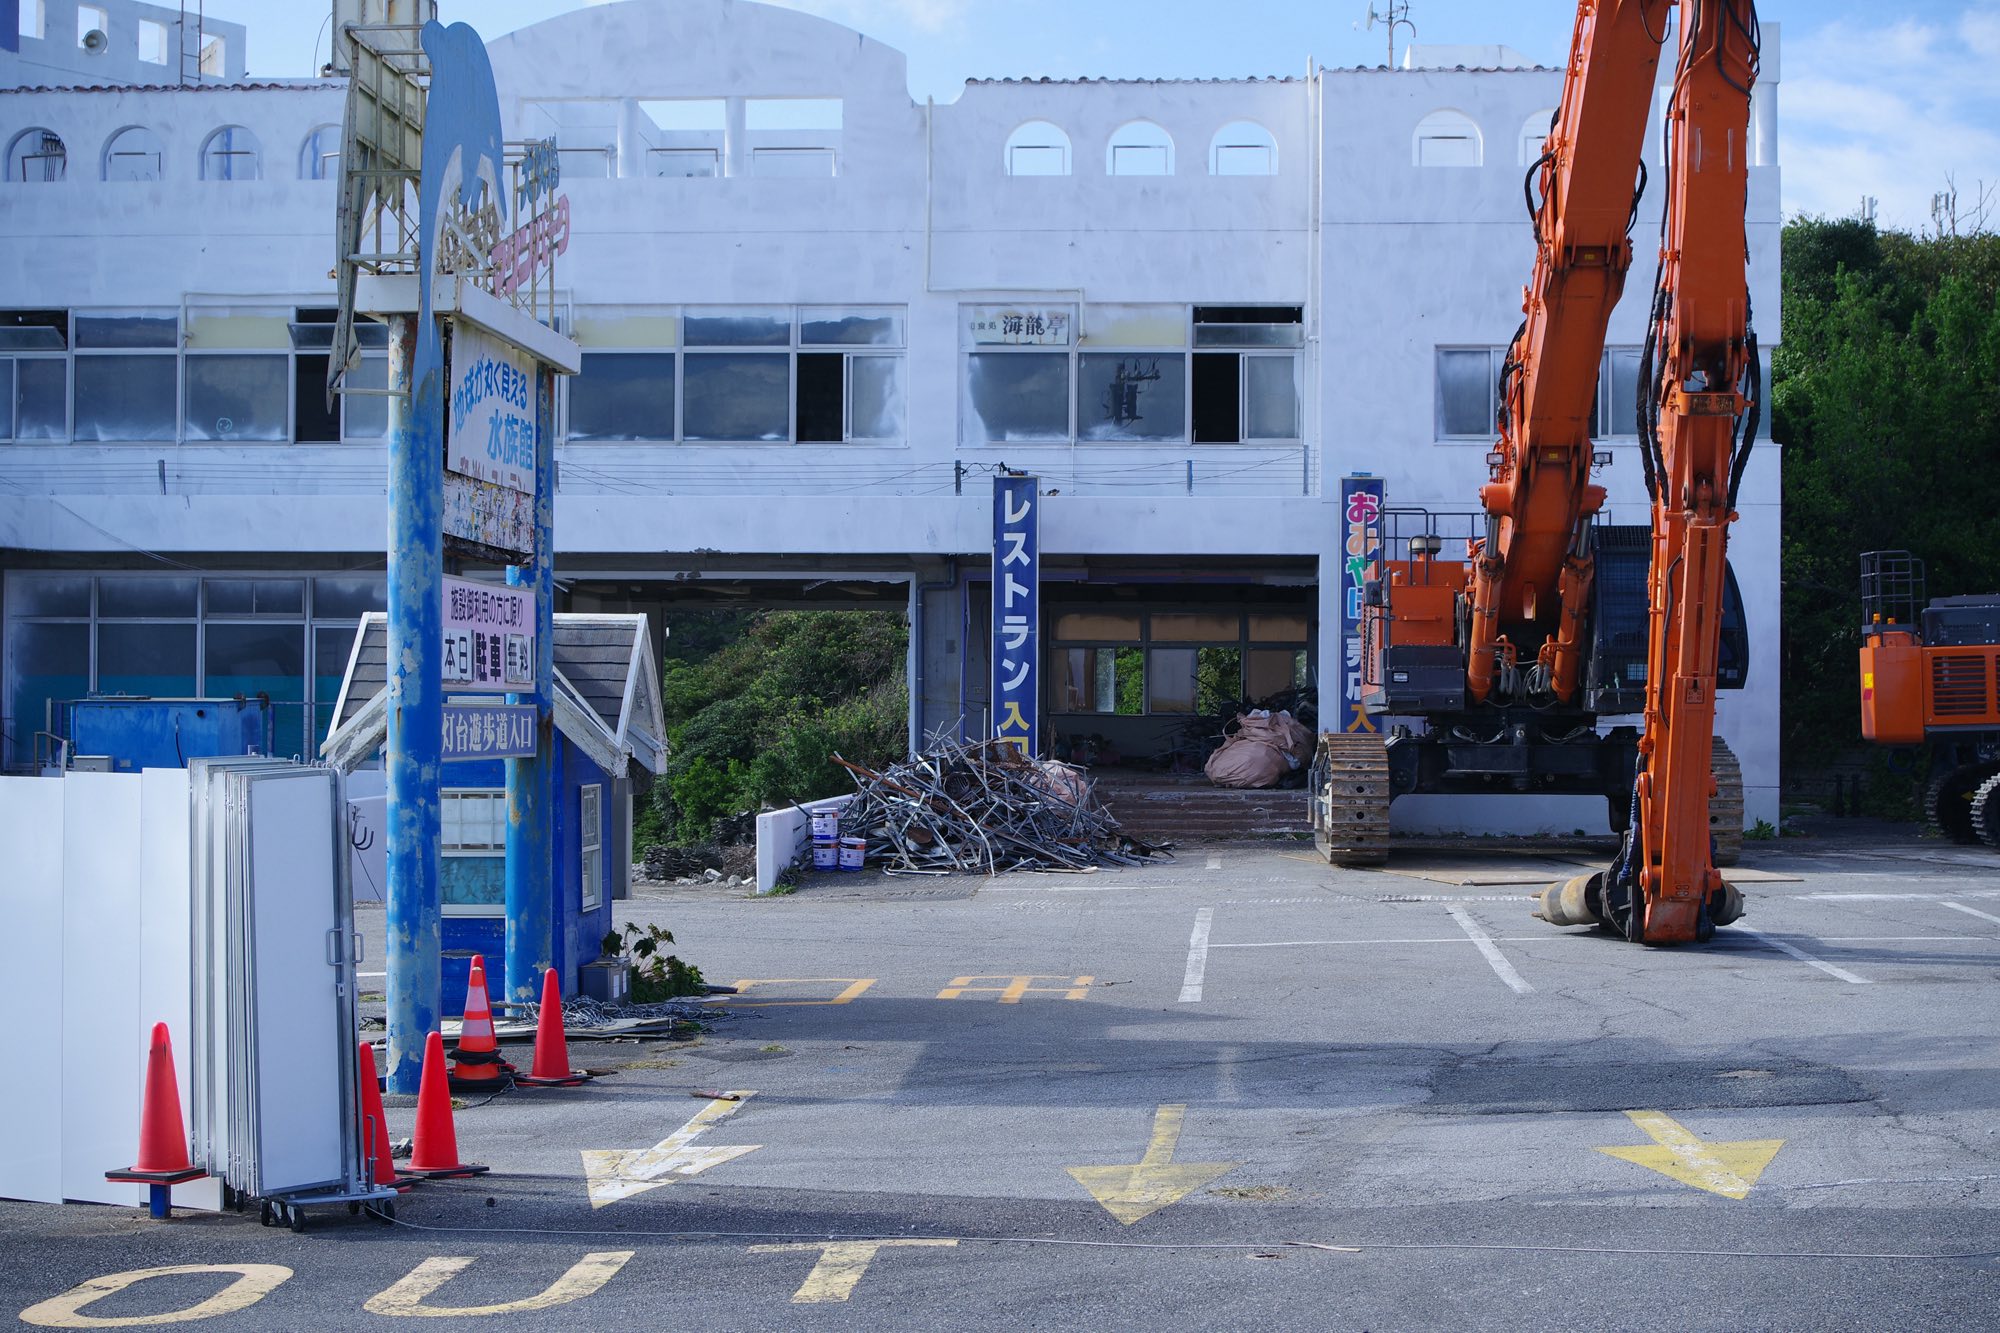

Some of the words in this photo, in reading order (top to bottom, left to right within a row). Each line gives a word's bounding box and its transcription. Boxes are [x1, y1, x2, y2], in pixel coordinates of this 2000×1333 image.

[453, 353, 528, 437] 地球が丸く見える
[486, 409, 534, 471] 水族館
[450, 586, 524, 628] 施設御利用の方に限り
[441, 712, 532, 753] 灯台遊歩道入口
[18, 1239, 958, 1328] OUT
